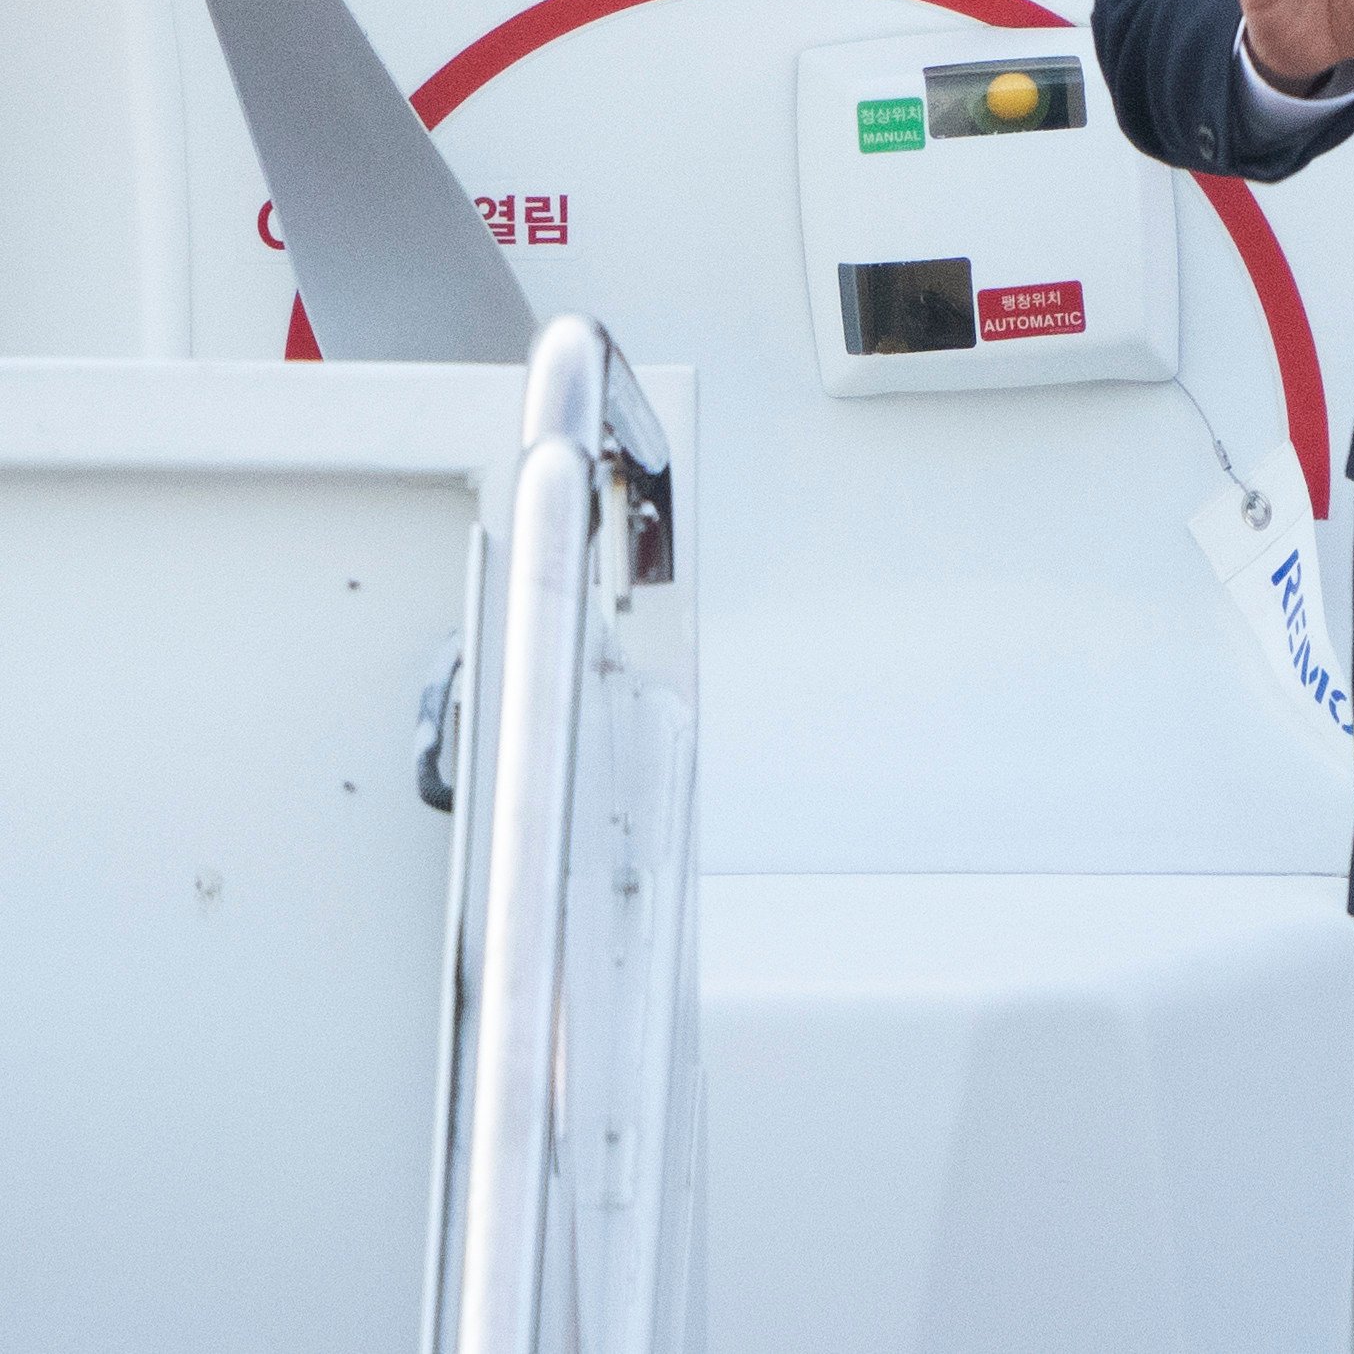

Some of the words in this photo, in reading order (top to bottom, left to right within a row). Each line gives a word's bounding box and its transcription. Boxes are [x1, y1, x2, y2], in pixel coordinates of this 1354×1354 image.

[863, 130, 922, 144] MANUAL
[1001, 290, 1061, 311] 팽창위치
[983, 310, 1083, 333] AUTOMATIC
